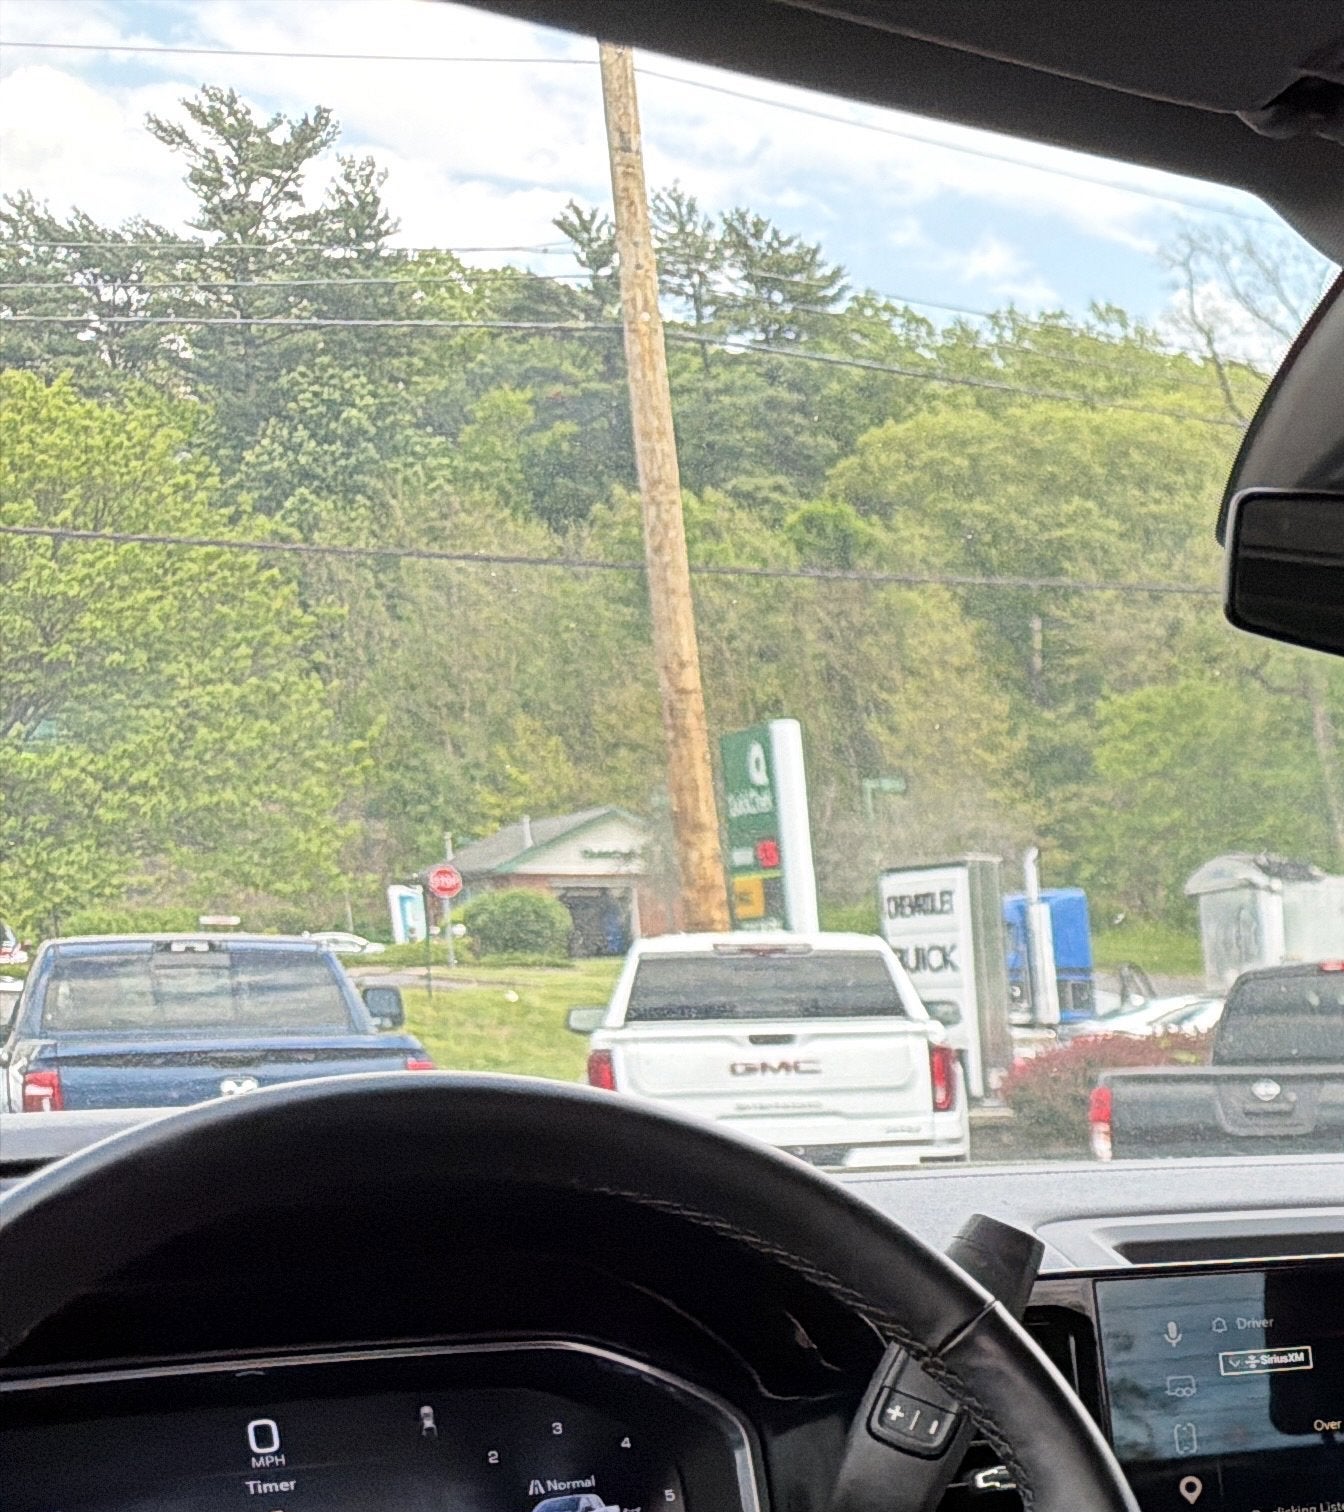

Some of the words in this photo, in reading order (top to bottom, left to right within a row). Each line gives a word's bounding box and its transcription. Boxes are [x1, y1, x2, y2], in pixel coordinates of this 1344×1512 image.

[729, 1059, 823, 1076] GMC
[1235, 1317, 1275, 1330] Driver
[1259, 1352, 1304, 1366] SiriusXM
[552, 1421, 562, 1434] 3
[1313, 1418, 1342, 1432] Over
[621, 1437, 631, 1448] 4
[251, 1454, 286, 1468] MPH
[488, 1450, 499, 1463] 2
[245, 1479, 297, 1495] Timer
[546, 1475, 596, 1491] Normal
[664, 1488, 675, 1501] 5
